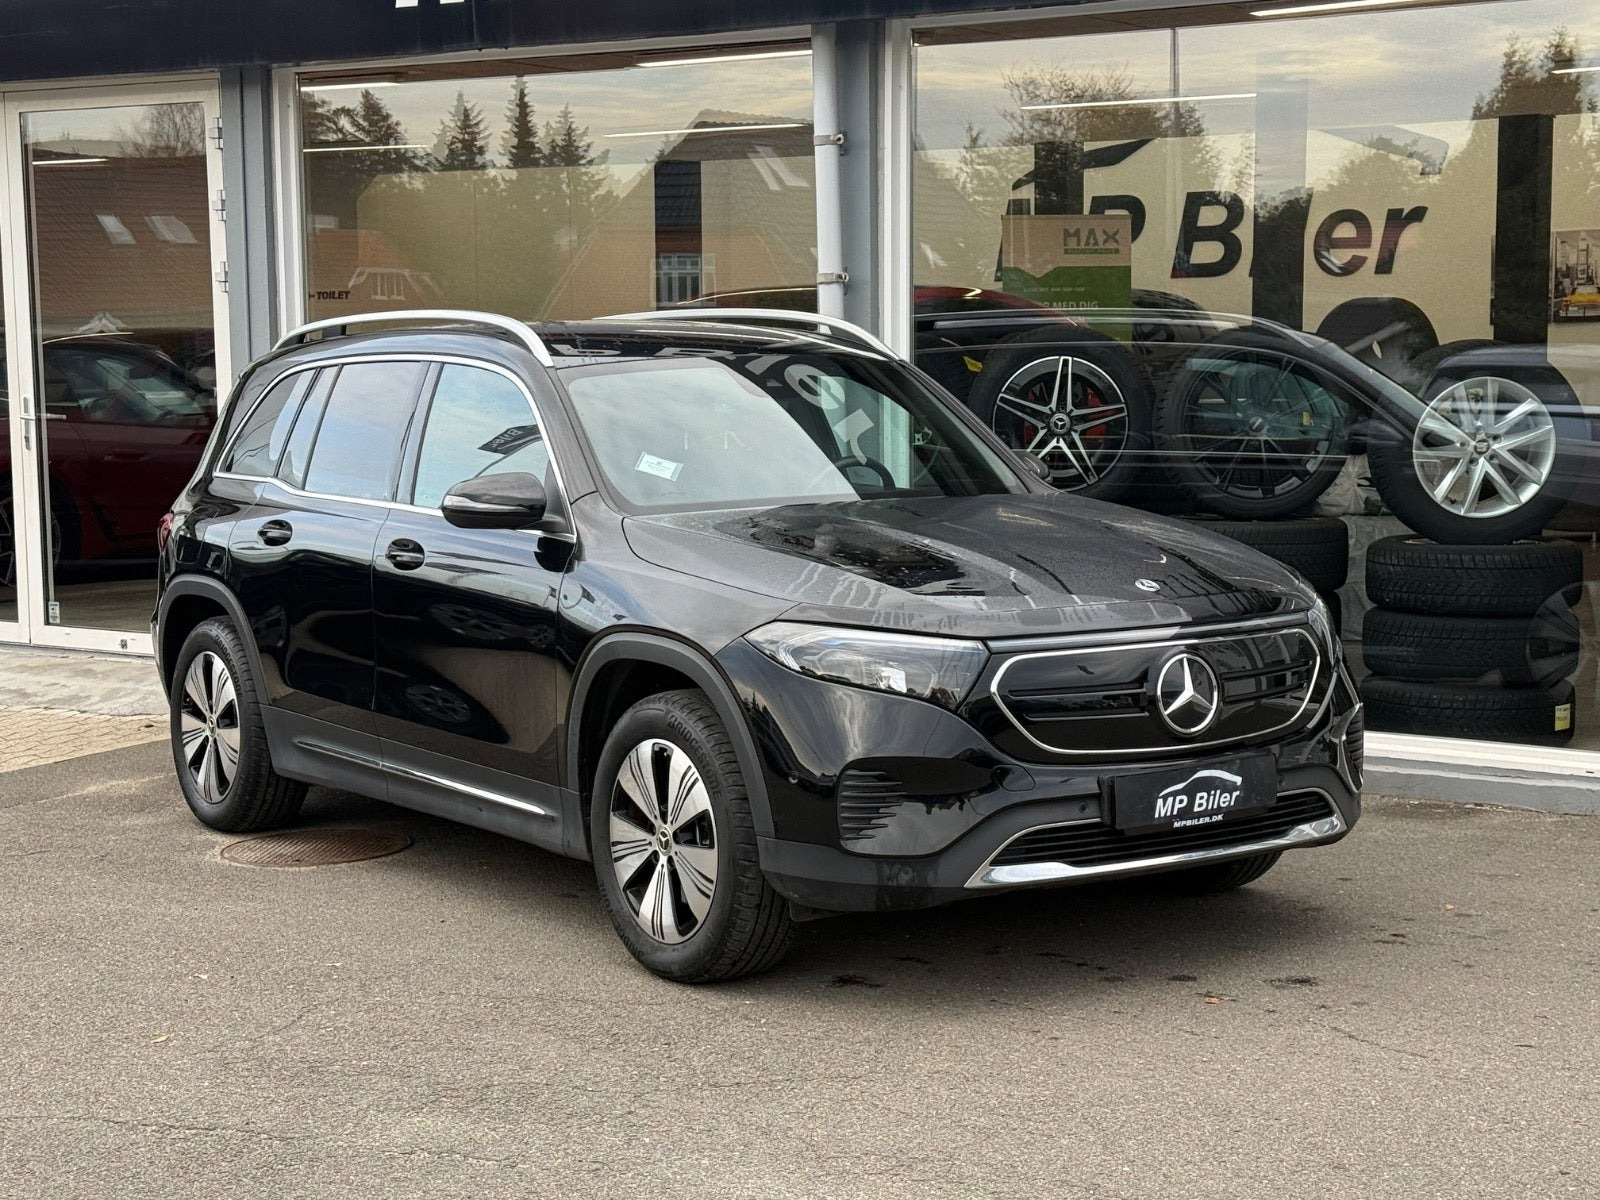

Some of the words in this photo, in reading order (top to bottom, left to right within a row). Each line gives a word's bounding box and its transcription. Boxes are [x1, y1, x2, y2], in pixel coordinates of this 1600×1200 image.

[1063, 228, 1120, 248] MAX
[1171, 191, 1428, 279] Ber
[316, 290, 351, 300] TOILET
[1154, 795, 1188, 818] MP
[1193, 789, 1240, 813] Biler
[1173, 815, 1224, 828] MPBILER.DK
